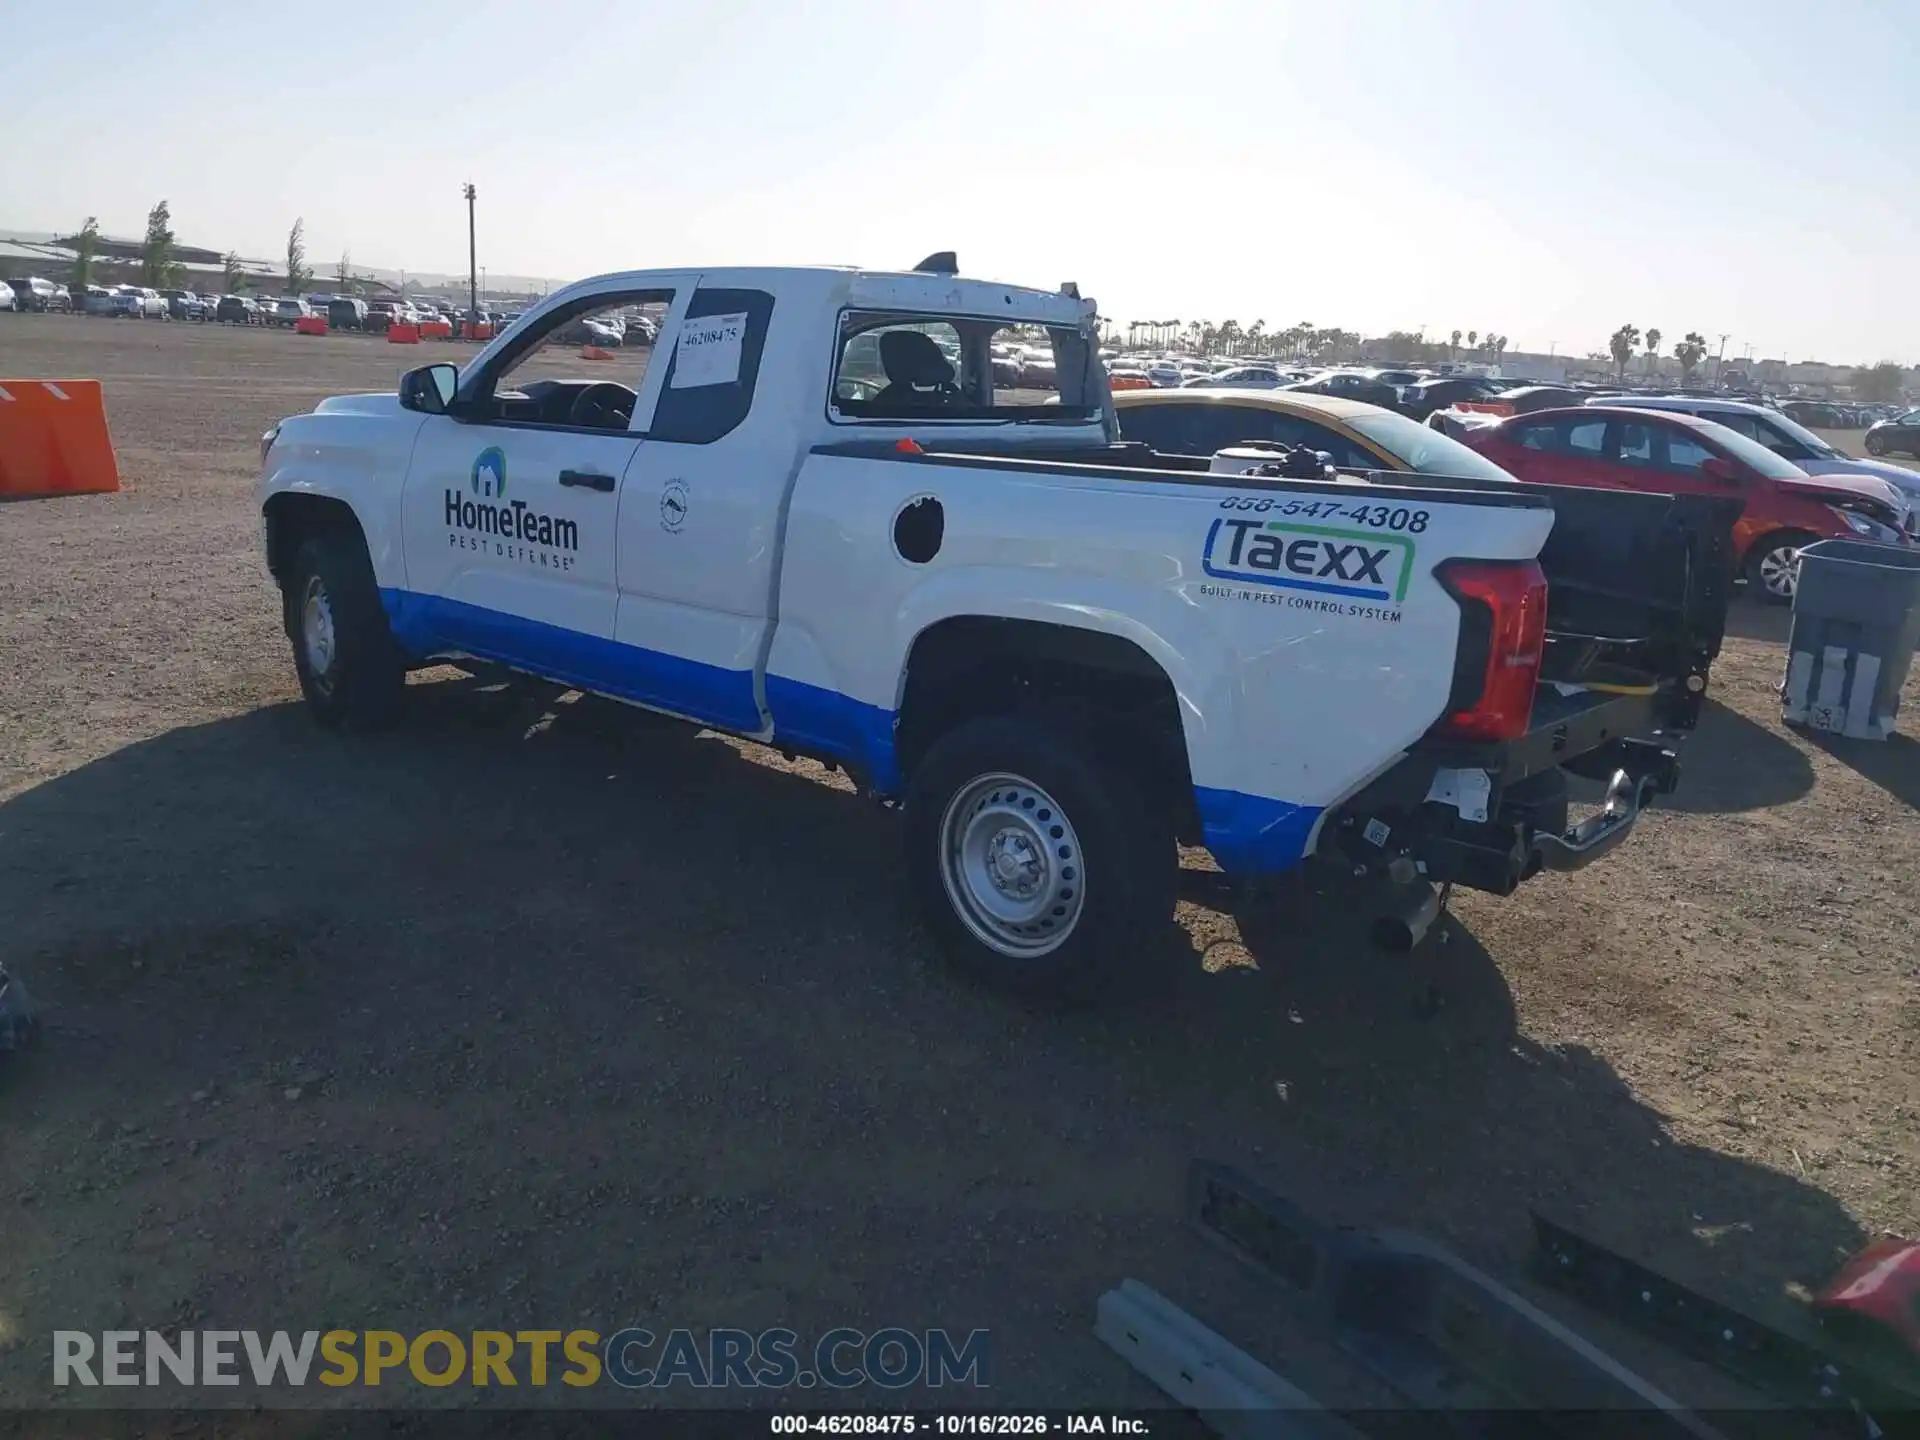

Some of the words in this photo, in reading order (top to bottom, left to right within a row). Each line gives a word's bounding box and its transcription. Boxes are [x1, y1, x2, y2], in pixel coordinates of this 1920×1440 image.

[683, 327, 737, 347] 46208475
[445, 488, 578, 551] HomeTeam
[449, 533, 487, 553] PEST
[1225, 518, 1392, 585] Taexx
[1200, 584, 1250, 601] BUILT-IN
[1255, 592, 1284, 605] PEST
[1287, 596, 1345, 615] CONTROL
[1348, 604, 1401, 623] SYSTEM
